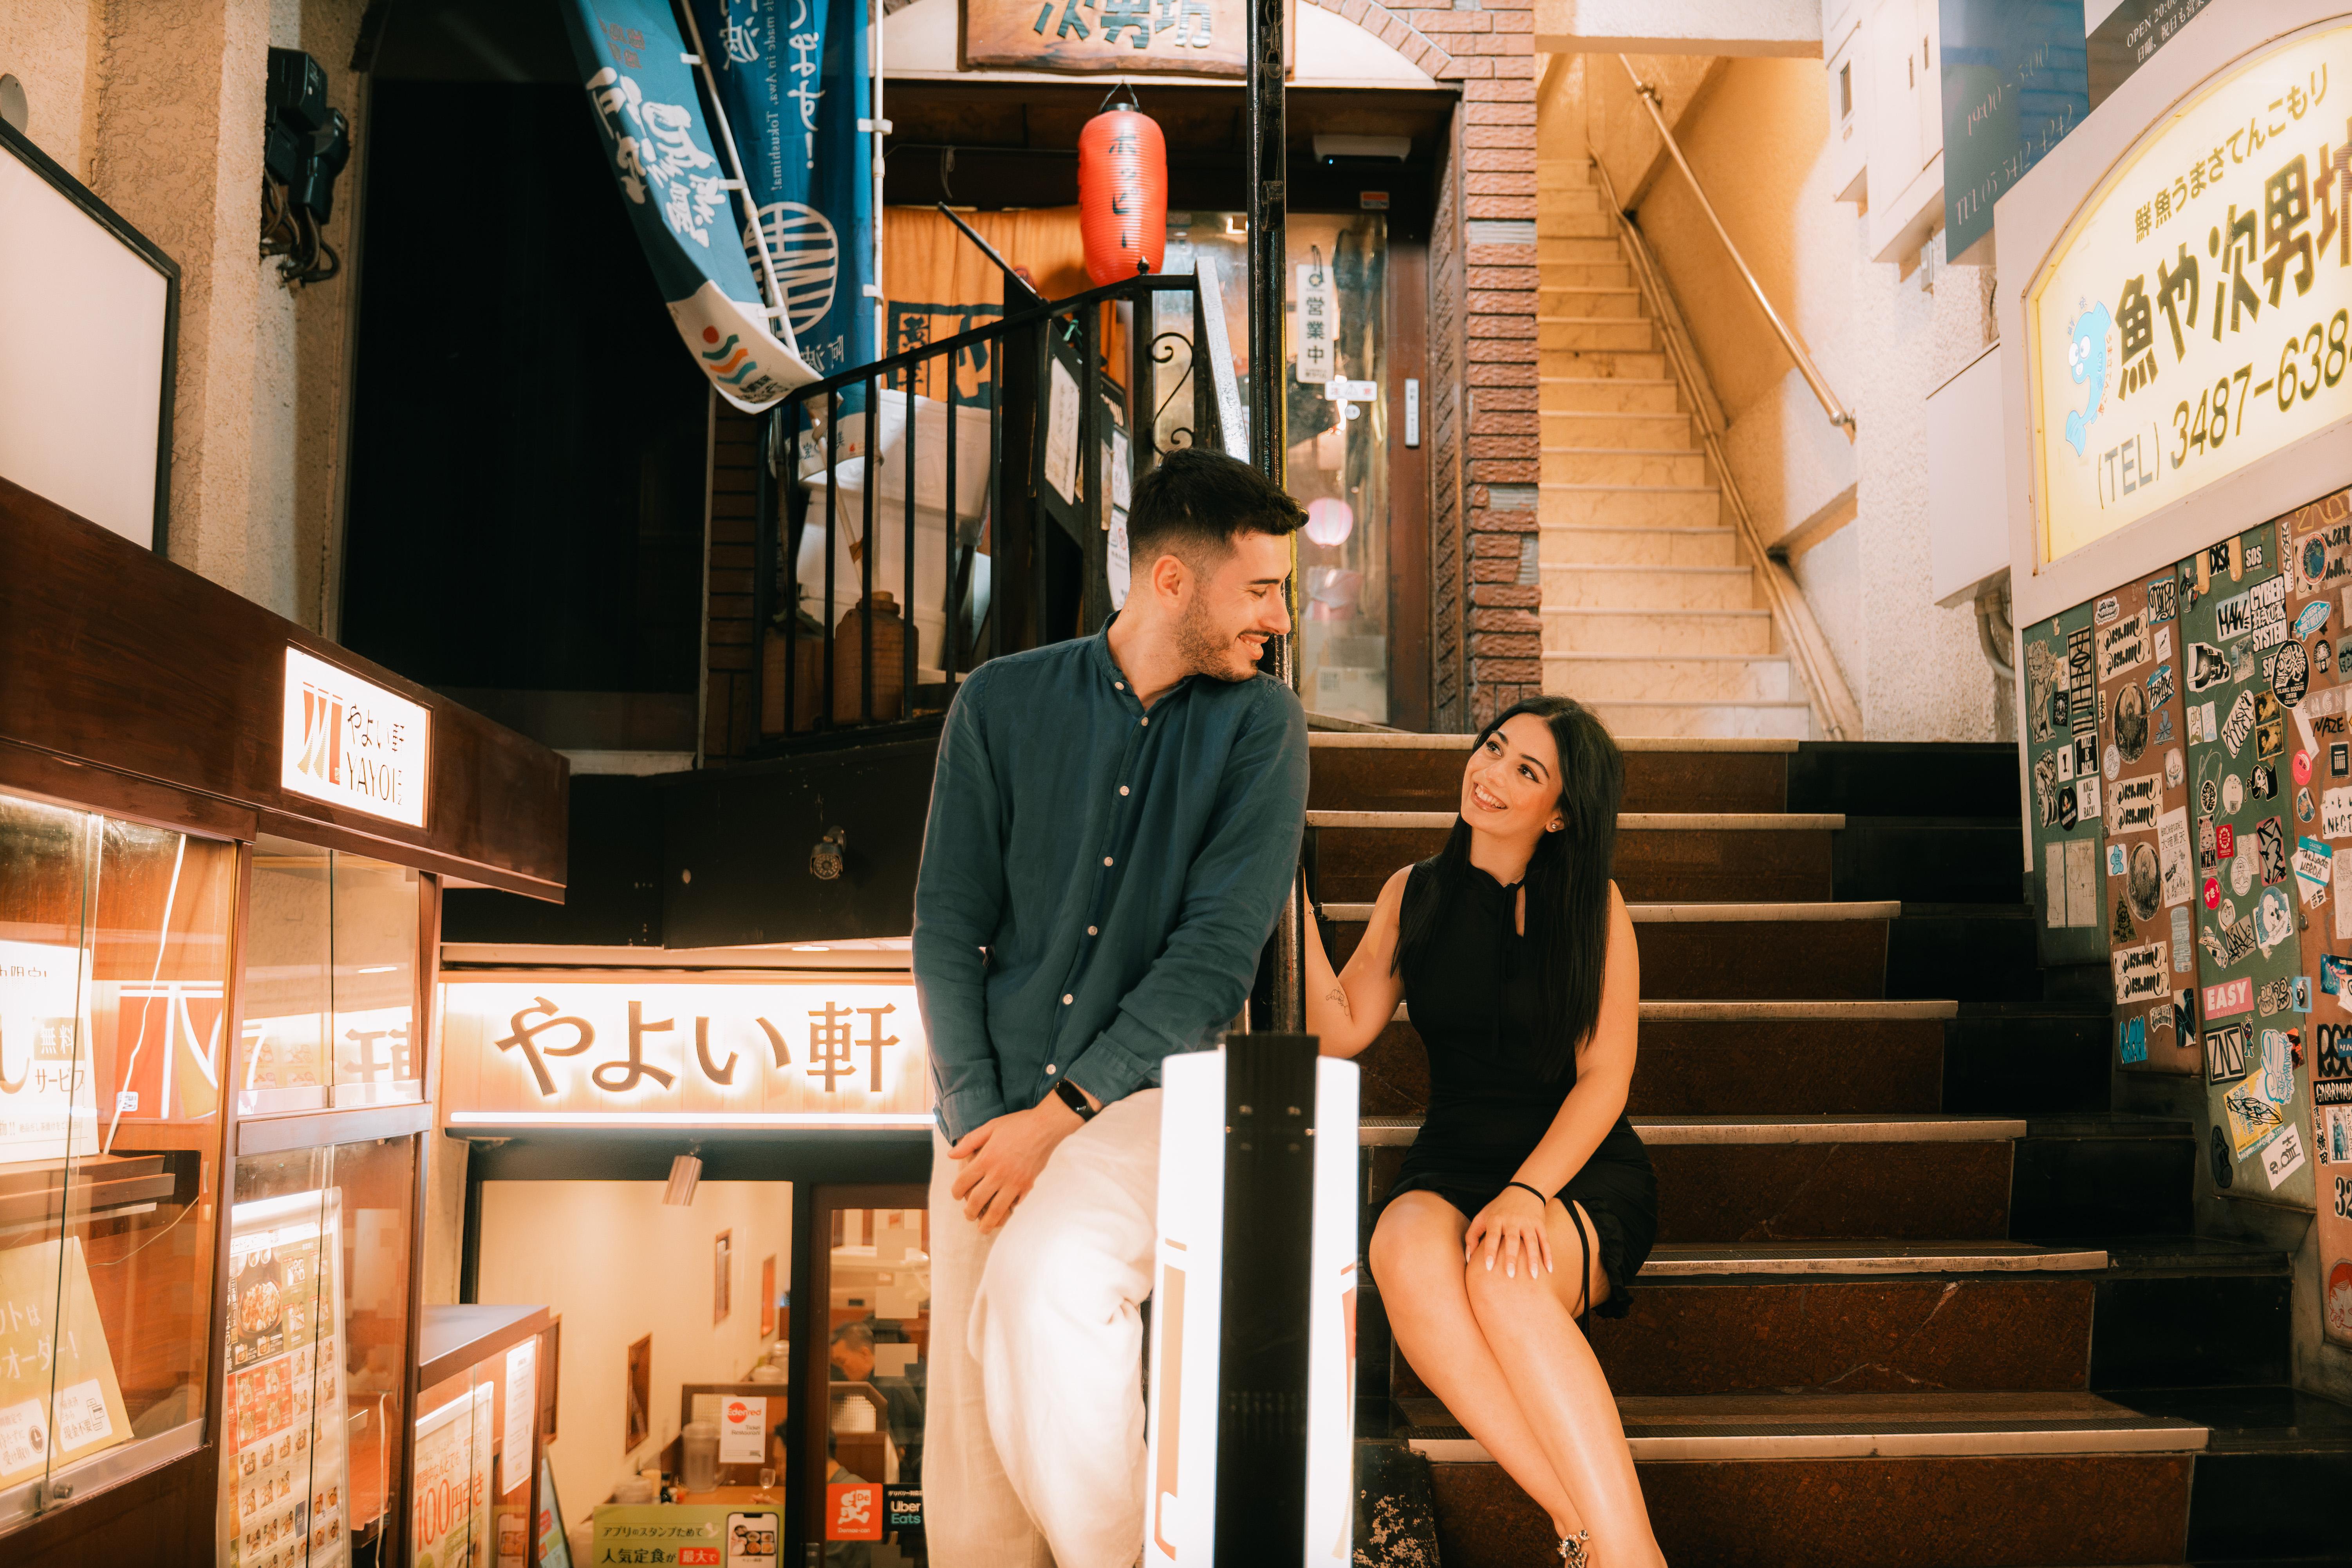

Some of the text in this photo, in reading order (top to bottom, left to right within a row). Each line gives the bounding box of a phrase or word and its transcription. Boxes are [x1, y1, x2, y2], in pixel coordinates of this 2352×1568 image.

[2127, 15, 2151, 47] OPEN
[2134, 62, 2329, 244] 鮮魚うまさてんこもり
[1108, 134, 1138, 249] ホッピー
[1306, 296, 1326, 364] 営業中
[2098, 307, 2352, 510] (TEL) 3487-638
[2245, 546, 2262, 567] SOS
[2250, 576, 2285, 611] CYBER
[2252, 618, 2288, 652] SYSTEM
[2263, 657, 2276, 677] SO
[2081, 760, 2094, 774] BACK!
[2085, 748, 2090, 761] IS
[2084, 805, 2095, 818] BACK!
[2087, 793, 2091, 805] IS
[2207, 981, 2247, 1012] EASY
[41, 1024, 74, 1055] 無料
[494, 996, 900, 1096] やよい軒
[35, 1068, 85, 1093] サービス
[2316, 1082, 2352, 1102] GNARMAD
[0, 1331, 78, 1379] オーダー!
[890, 1501, 921, 1513] Uber
[891, 1513, 921, 1524] Eats
[602, 1526, 703, 1538] アプリのスタンプためて
[602, 1548, 717, 1564] 人気定食が 最大で
